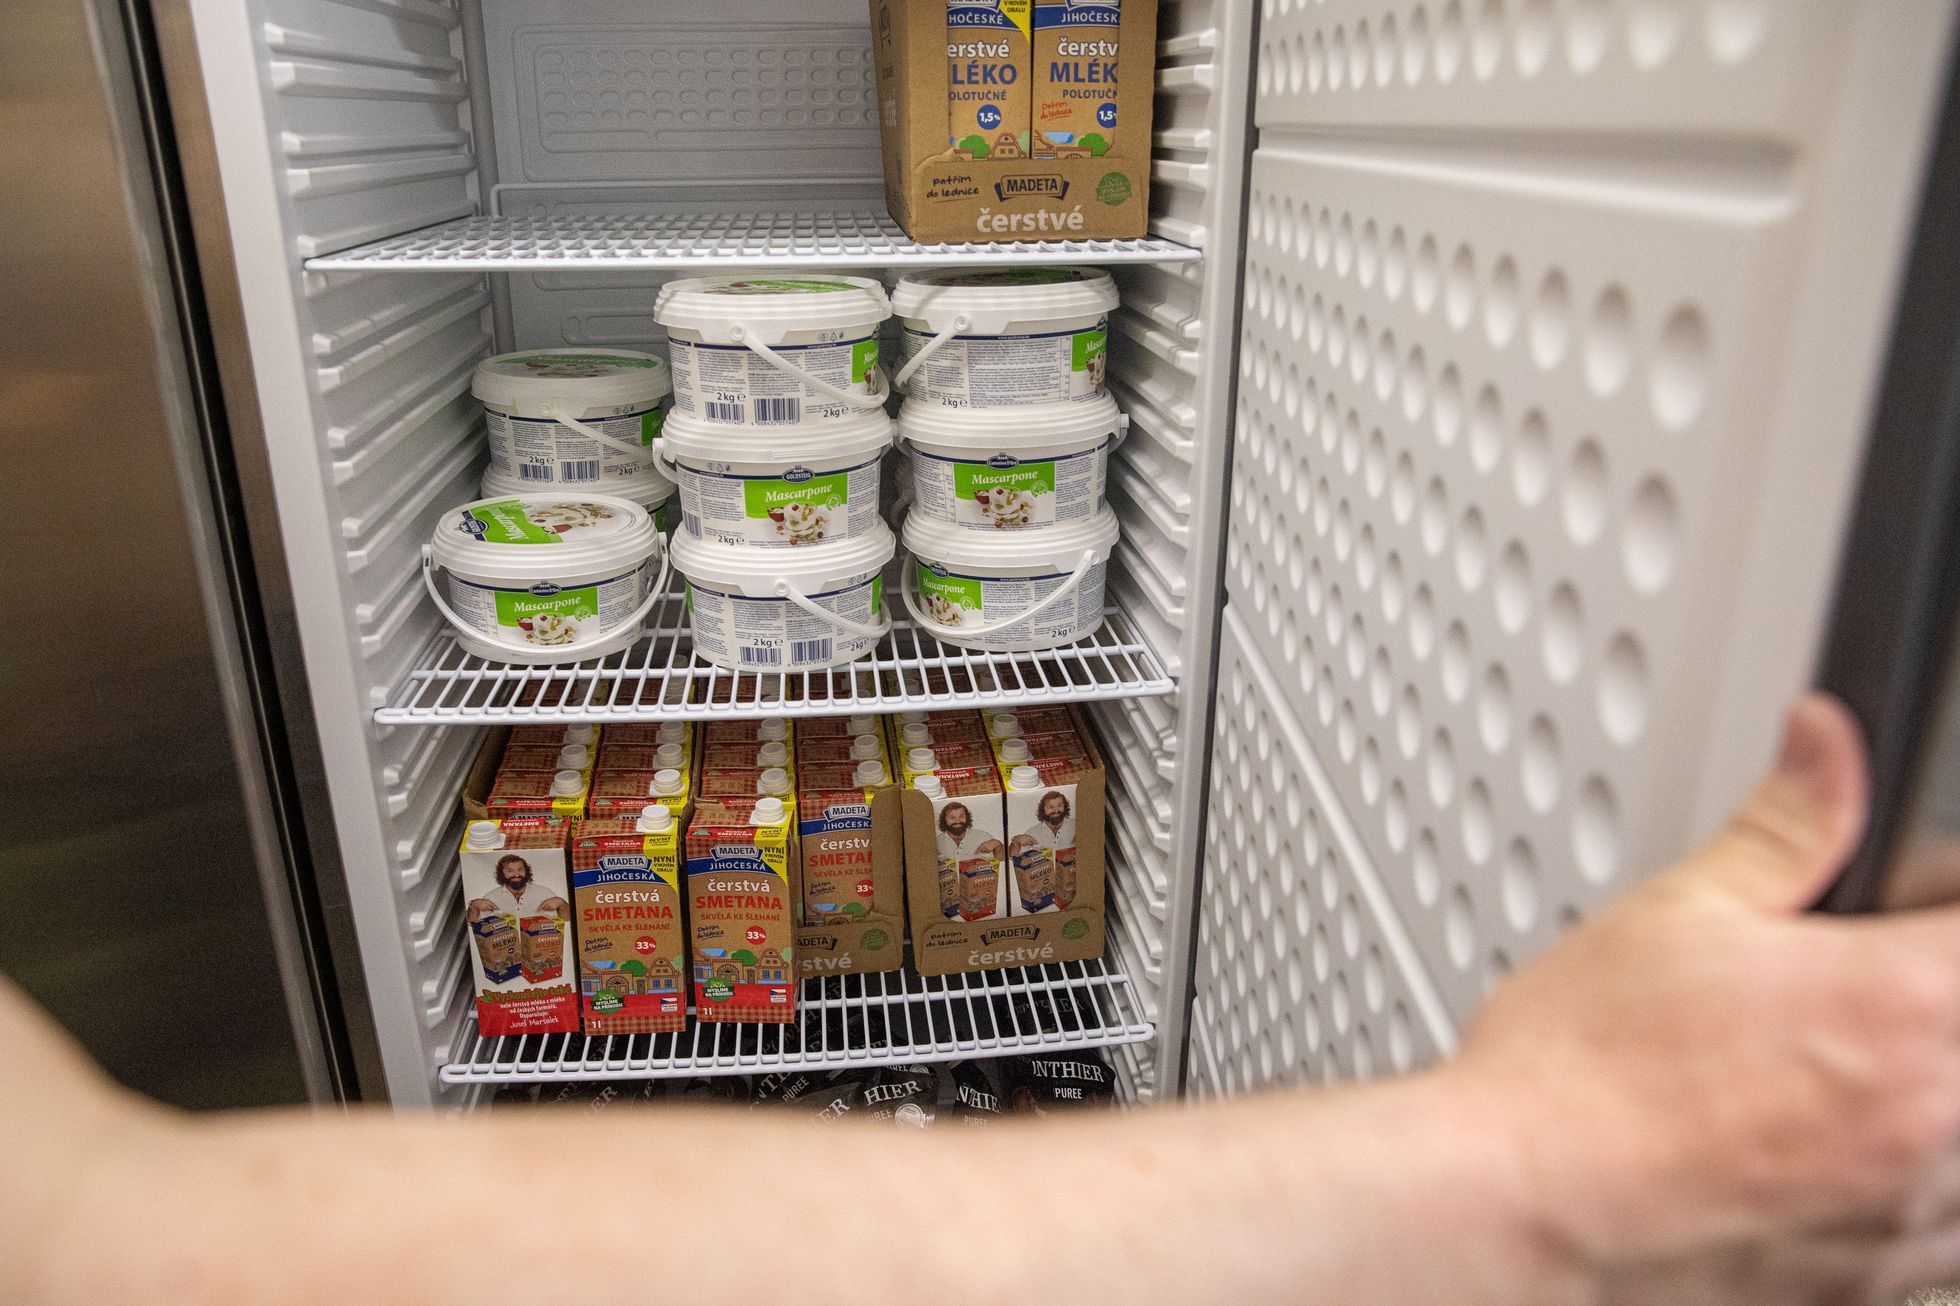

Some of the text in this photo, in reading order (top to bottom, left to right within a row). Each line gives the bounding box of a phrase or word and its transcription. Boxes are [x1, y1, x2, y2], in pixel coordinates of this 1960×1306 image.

[1061, 11, 1119, 23] JIHOČESK
[947, 39, 1011, 58] erstvé
[1057, 37, 1120, 57] čerstv
[952, 60, 1018, 86] LÉKO
[1050, 59, 1119, 84] MLÉK
[949, 89, 1007, 101] OLOTUČNÉ
[932, 175, 972, 187] patřím
[1006, 178, 1059, 192] MADETA
[926, 187, 980, 199] do lednice
[976, 204, 1084, 233] čerstvé
[717, 392, 735, 404] 2 kg
[942, 397, 958, 409] 2 kg
[823, 408, 840, 419] 2 kg
[535, 456, 545, 465] kg
[619, 467, 633, 476] 2 kg
[971, 469, 1038, 485] Mascarpone
[765, 483, 834, 502] Mascarpone
[718, 534, 734, 546] 2 kg
[923, 577, 966, 595] Mascarpone
[514, 595, 581, 612] Mascarpone
[1051, 628, 1068, 638] 2 kg
[753, 638, 772, 648] 2 kg
[851, 641, 864, 651] 2 kg
[832, 806, 867, 815] MADETA
[822, 820, 872, 831] JIHOČESK
[764, 846, 785, 855] NYNÍ
[820, 838, 870, 851] čerstv
[719, 847, 756, 855] MADETA
[607, 857, 645, 866] MADETA
[653, 855, 675, 863] NYNÍ
[709, 861, 767, 871] JIHOČESKÁ
[597, 870, 656, 881] JIHOČESKÁ
[707, 879, 770, 893] čerstvá
[595, 888, 660, 904] čerstvá
[696, 895, 782, 910] SMETANA
[583, 905, 673, 922] SMETANA
[701, 913, 732, 921] SKVĚLÁ
[745, 912, 780, 921] ŠLEHÁNÍ
[746, 931, 766, 940] 33%
[990, 927, 1032, 940] MADETA
[636, 941, 656, 950] 33%
[967, 942, 1054, 966] čerstvé
[782, 1076, 810, 1102] PUREE
[1054, 1087, 1083, 1099] PUREE
